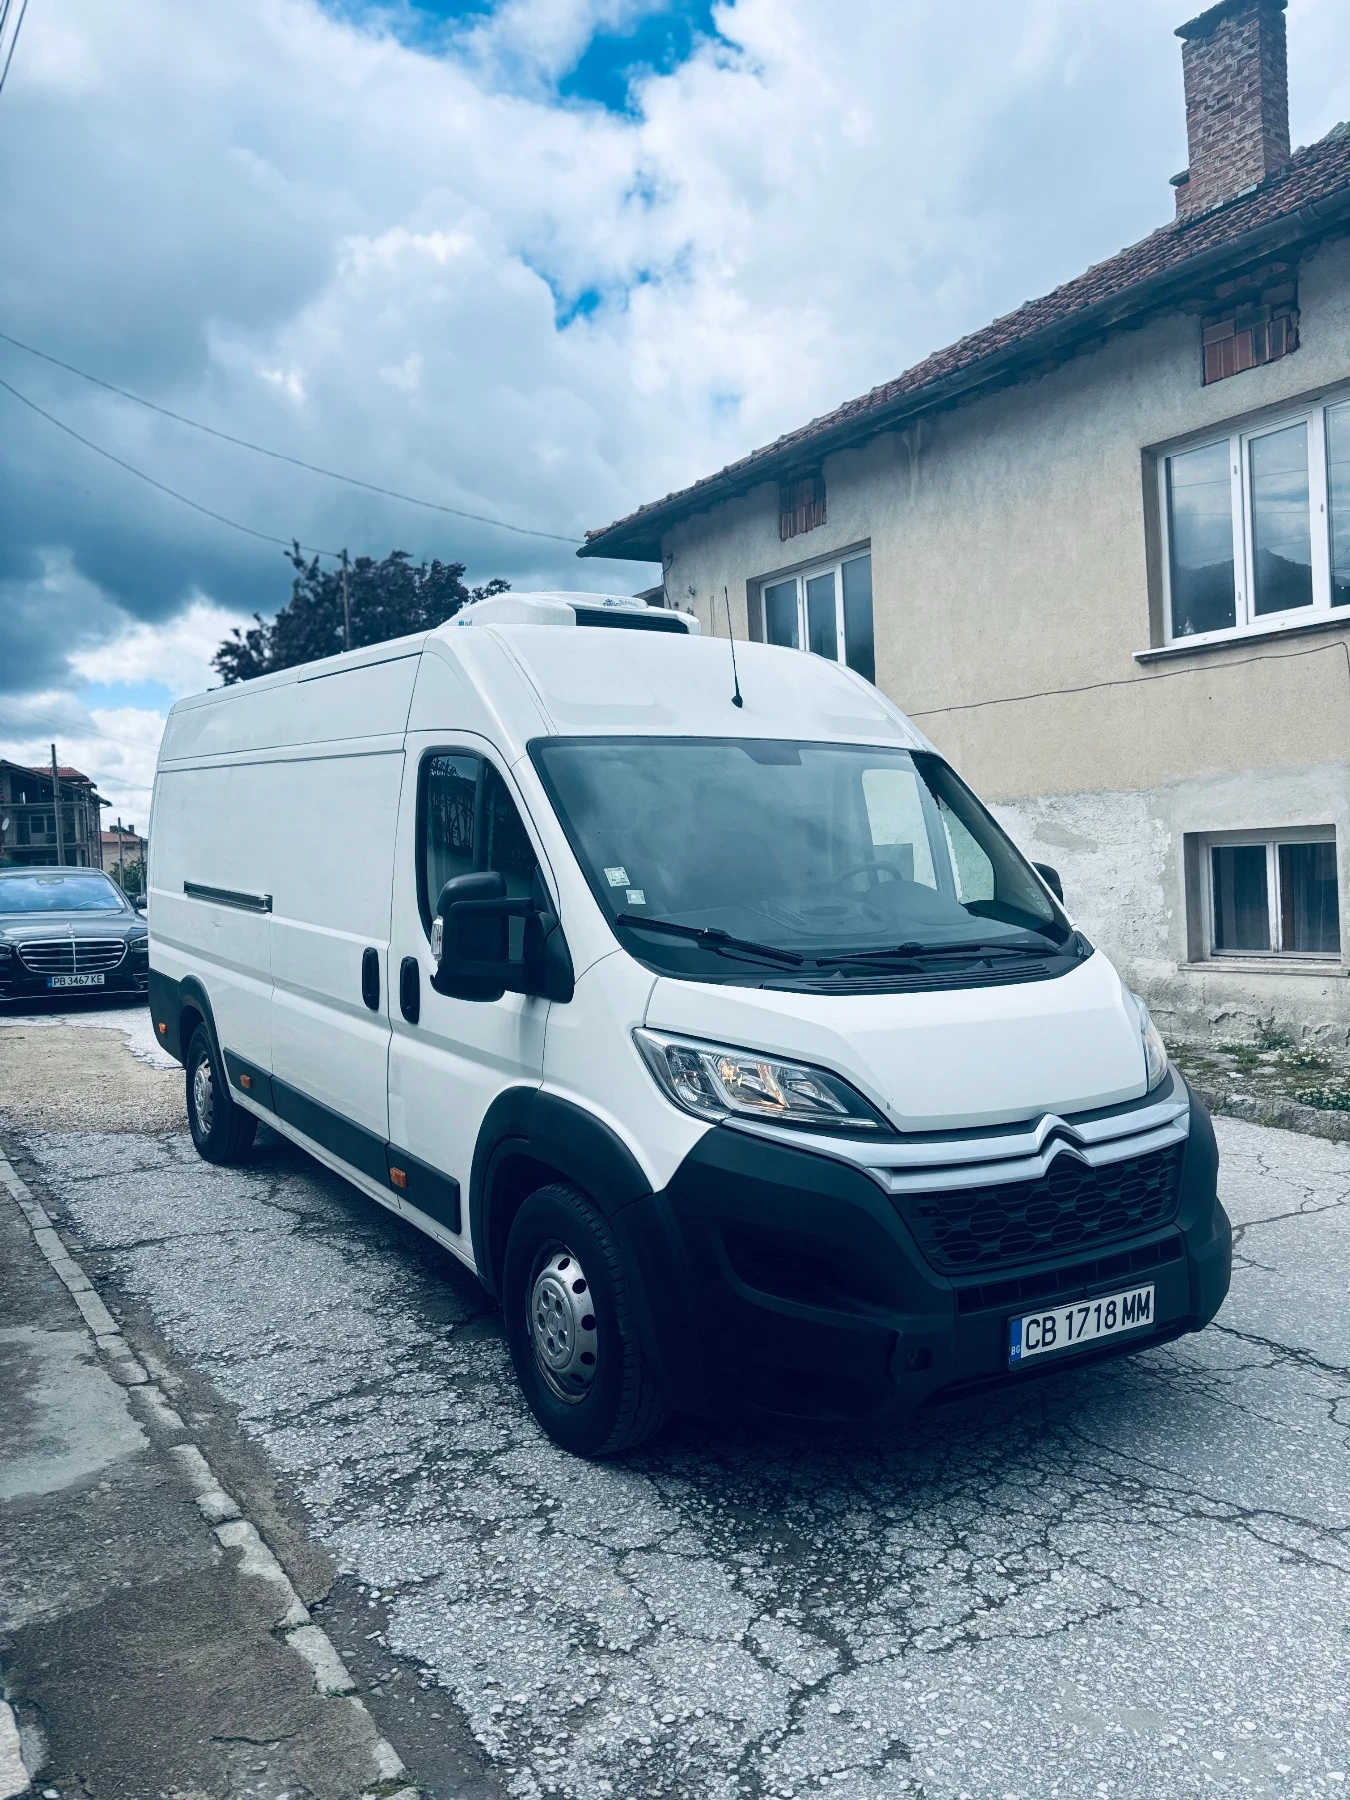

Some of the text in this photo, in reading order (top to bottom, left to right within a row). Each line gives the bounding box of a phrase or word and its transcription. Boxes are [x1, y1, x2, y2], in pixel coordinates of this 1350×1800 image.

[53, 975, 103, 986] PB 3467 KE
[1025, 1290, 1151, 1350] CB 1718 MM
[1011, 1345, 1021, 1356] BG
